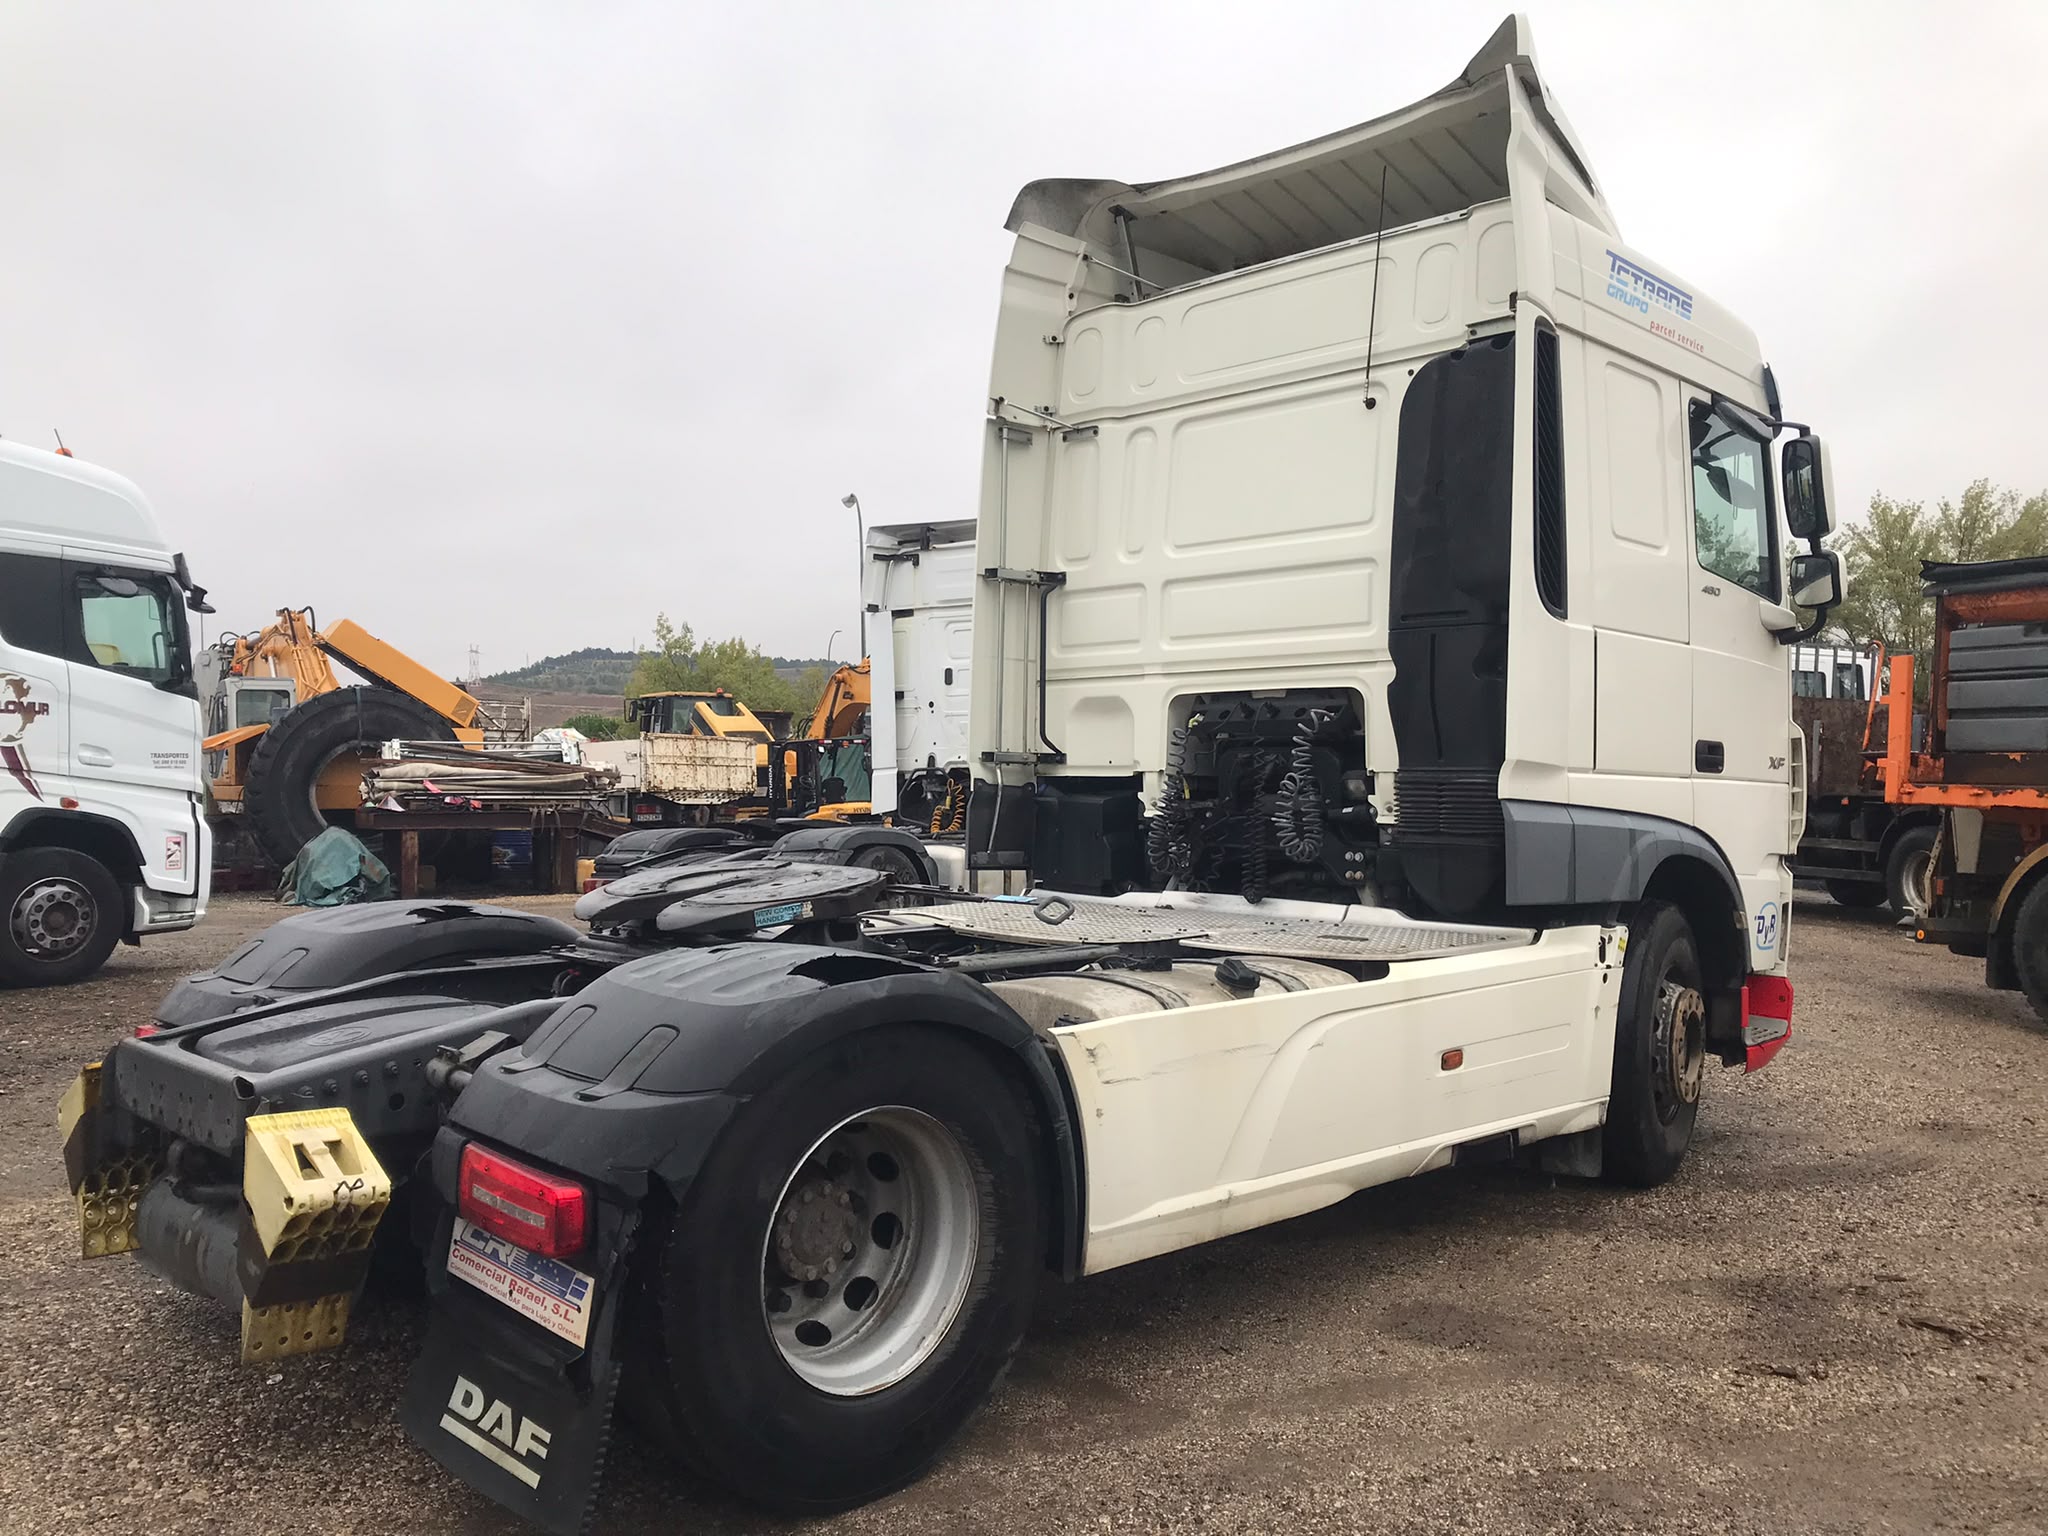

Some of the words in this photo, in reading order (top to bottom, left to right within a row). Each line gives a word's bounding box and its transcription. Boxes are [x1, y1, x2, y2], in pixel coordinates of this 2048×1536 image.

[1607, 283, 1649, 314] GRUPO
[1650, 321, 1675, 338] parcel
[1677, 334, 1705, 353] service
[1768, 756, 1786, 770] XF
[450, 1261, 489, 1290] Concesionario
[489, 1283, 509, 1298] Oficial
[508, 1294, 522, 1306] DAF
[521, 1303, 535, 1316] para
[452, 1247, 506, 1285] Comercial
[508, 1278, 548, 1311] Rafael,
[551, 1302, 575, 1324] S.L.
[448, 1375, 552, 1460] DAF
